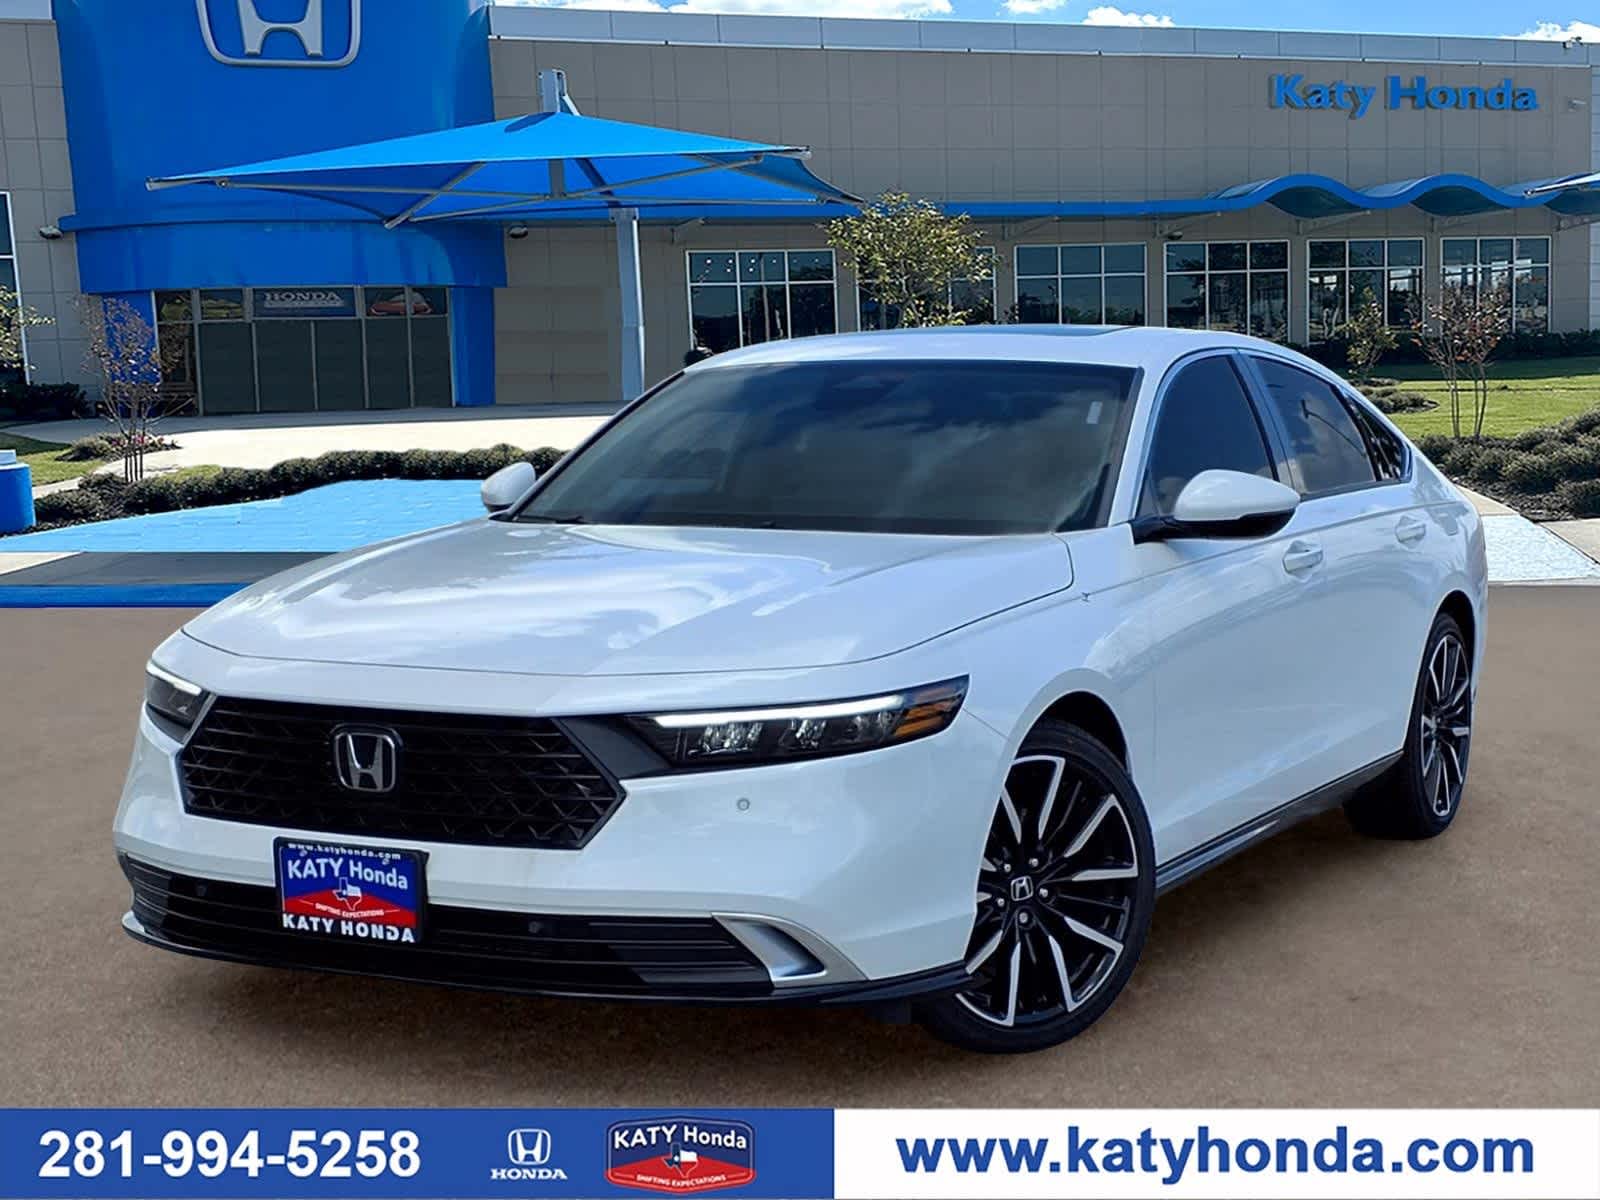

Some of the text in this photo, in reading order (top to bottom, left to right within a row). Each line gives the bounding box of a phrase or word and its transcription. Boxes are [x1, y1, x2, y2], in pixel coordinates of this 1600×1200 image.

[1270, 73, 1540, 119] Katy Honda
[264, 291, 342, 301] HONDA
[287, 843, 401, 860] www.katyhonda.com
[287, 857, 409, 890] KATY Honda
[282, 913, 415, 943] KATY HONDA
